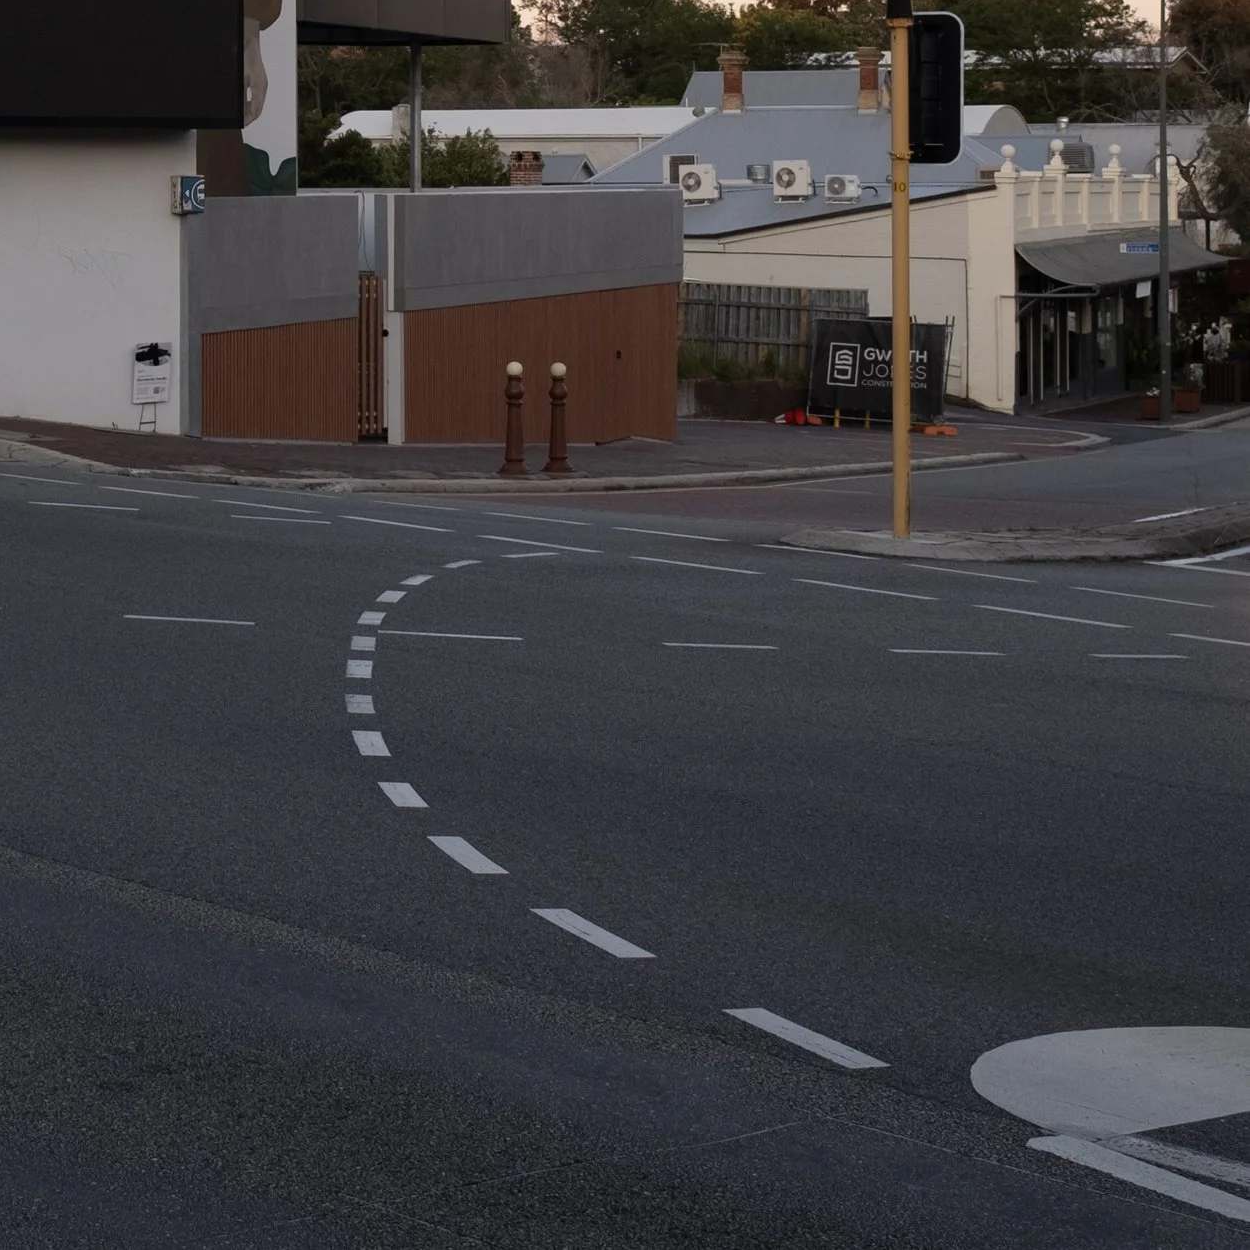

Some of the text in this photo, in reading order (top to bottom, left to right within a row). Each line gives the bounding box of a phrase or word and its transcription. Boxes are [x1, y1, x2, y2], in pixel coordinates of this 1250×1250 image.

[894, 181, 906, 192] 10
[863, 347, 928, 363] GWTH
[862, 363, 927, 380] JOES
[861, 379, 927, 389] CONSTION
